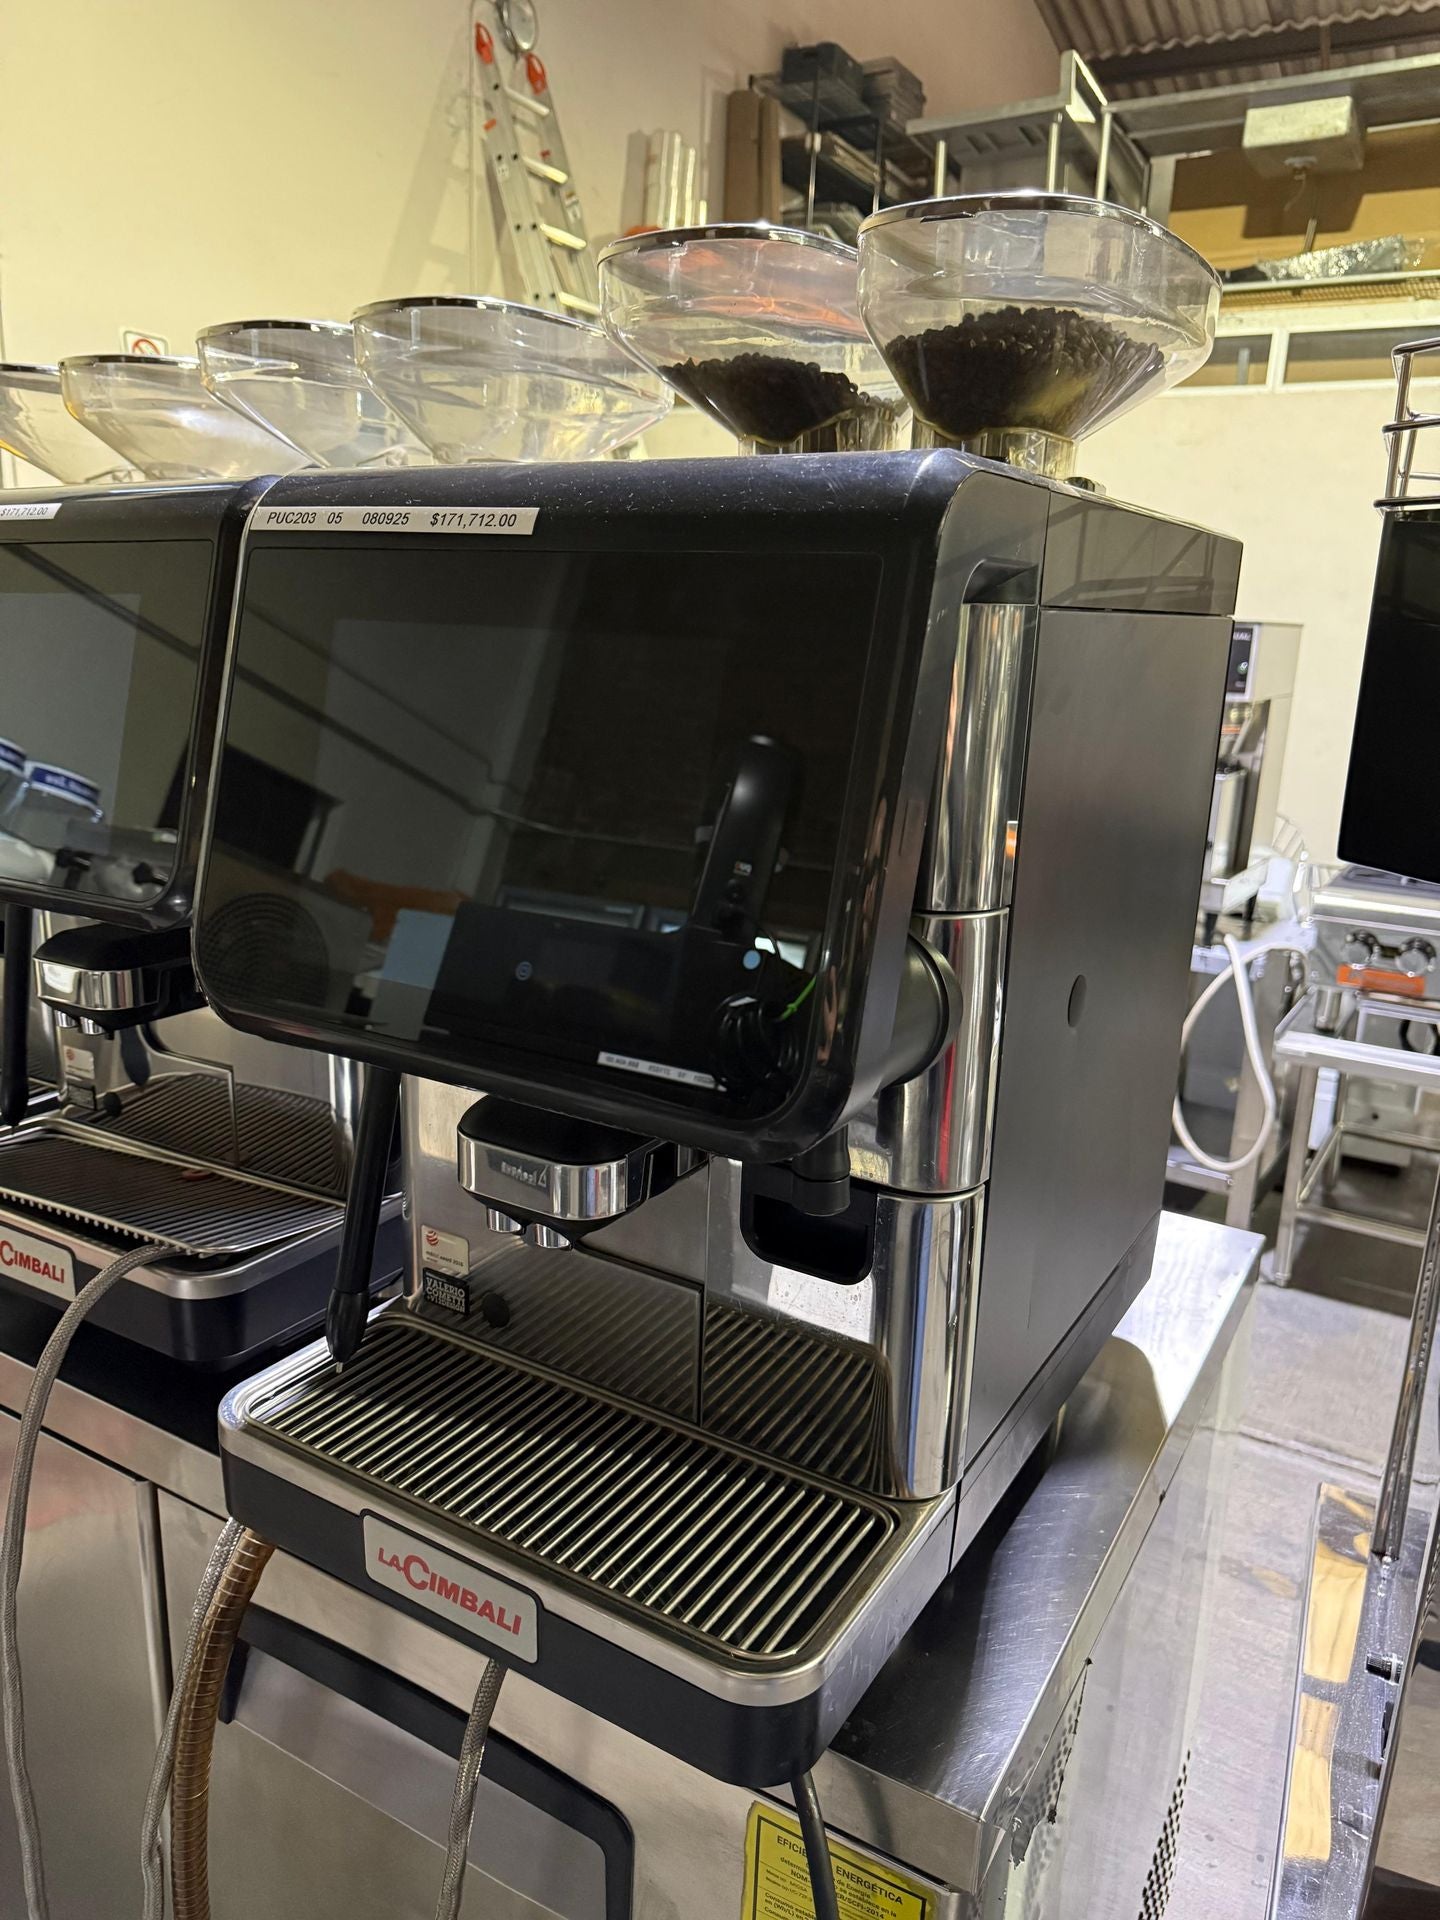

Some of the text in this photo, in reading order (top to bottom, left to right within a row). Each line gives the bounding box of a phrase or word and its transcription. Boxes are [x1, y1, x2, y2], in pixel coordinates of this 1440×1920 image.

[266, 511, 517, 529] PUC203 05 080925 $171,712.00
[426, 1277, 466, 1298] VALERIO
[836, 1865, 903, 1905] ENERGÉTICA
